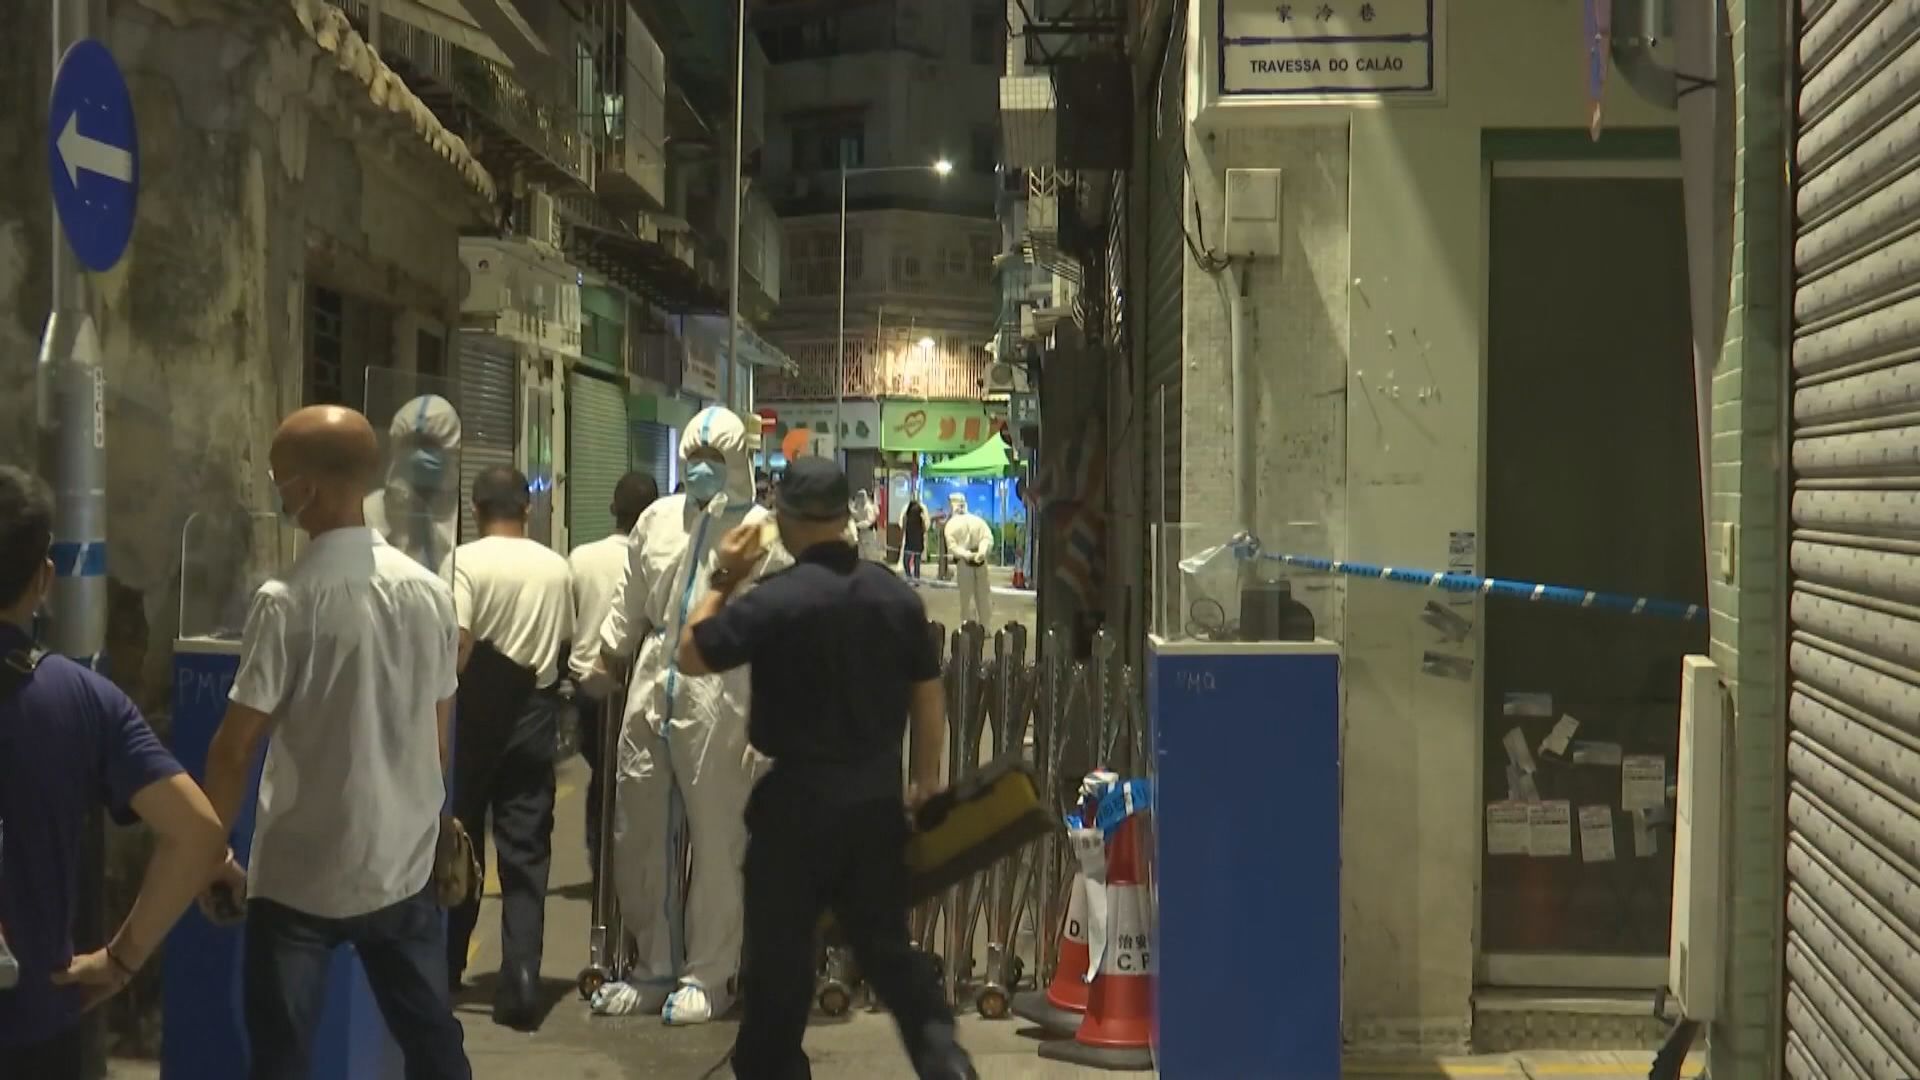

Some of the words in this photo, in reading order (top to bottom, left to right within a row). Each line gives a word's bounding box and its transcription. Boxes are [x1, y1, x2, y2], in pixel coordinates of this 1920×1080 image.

[1250, 58, 1321, 73] TRAVESSA
[1329, 58, 1349, 72] DO
[1356, 55, 1404, 72] CALÃO
